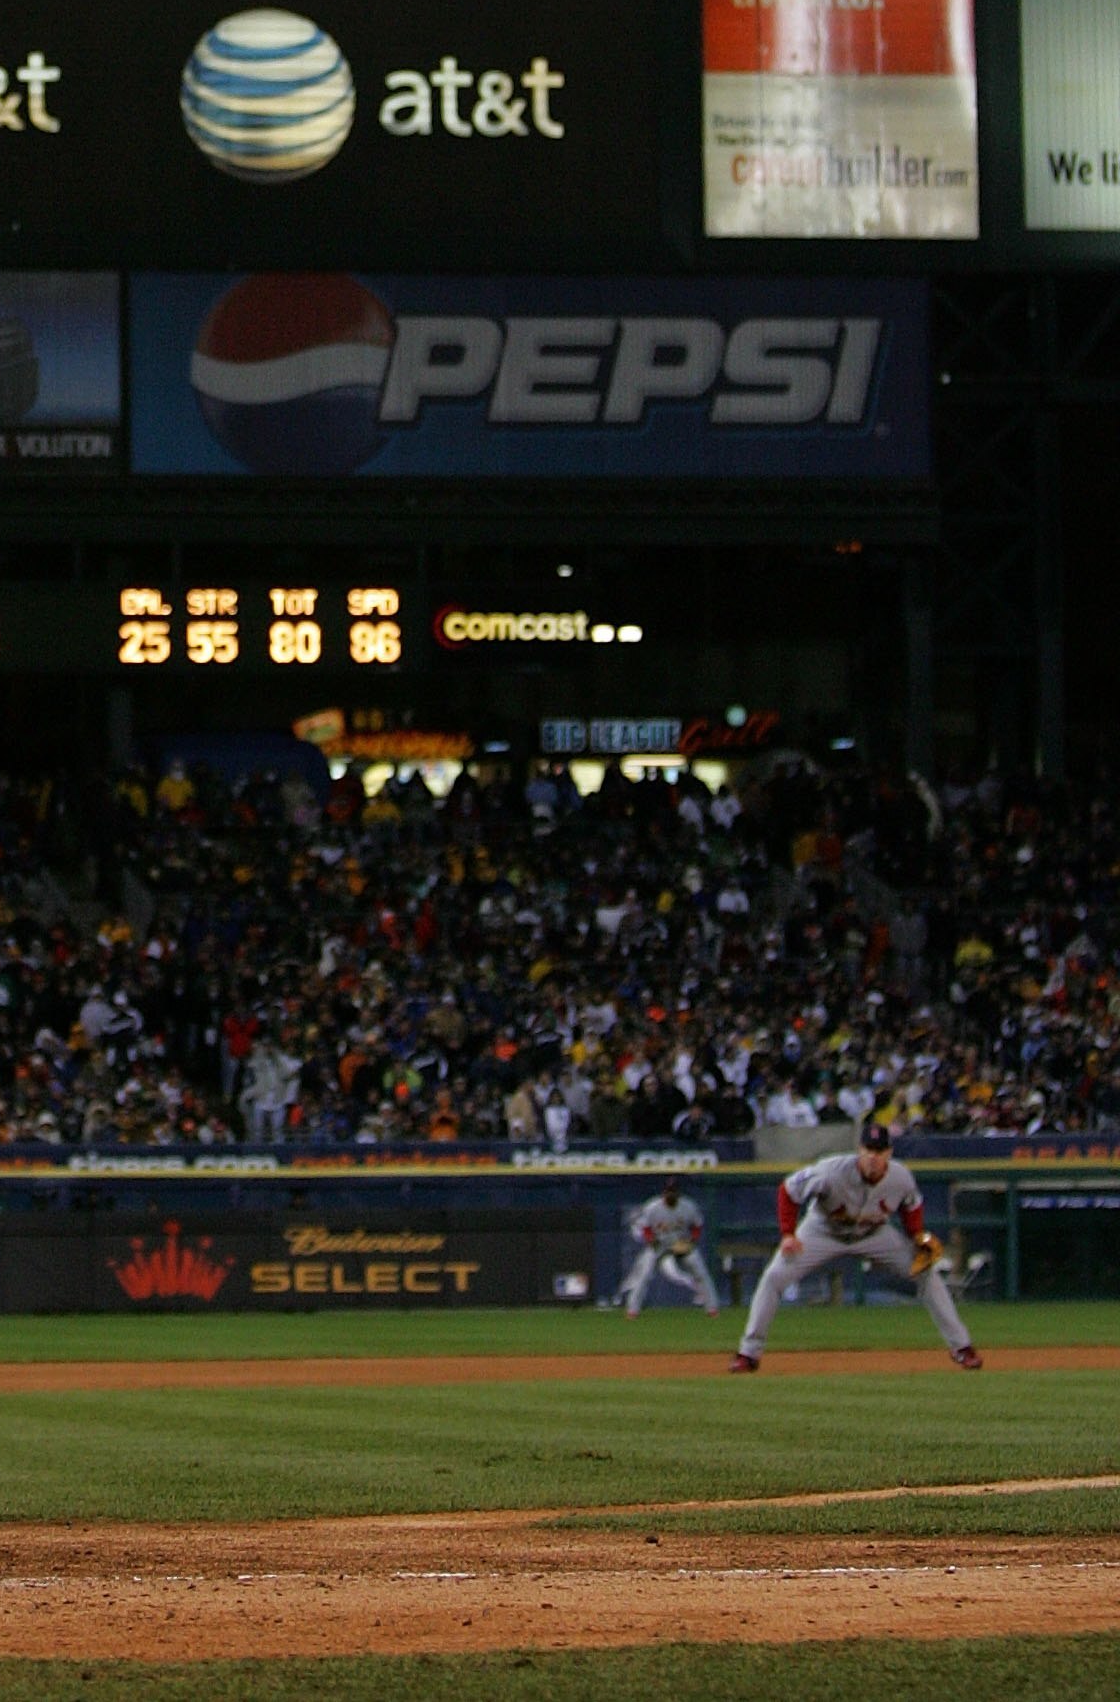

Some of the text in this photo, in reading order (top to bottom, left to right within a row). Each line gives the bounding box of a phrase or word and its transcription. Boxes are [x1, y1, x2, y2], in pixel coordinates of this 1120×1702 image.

[379, 56, 564, 139] at&t
[1047, 151, 1093, 185] We
[378, 317, 881, 425] PEPSI
[270, 588, 318, 615] TOT
[442, 610, 590, 642] comcast
[119, 622, 401, 664] 25 55 80 86
[591, 720, 681, 753] LEAGUE
[251, 1261, 479, 1293] SELECT
